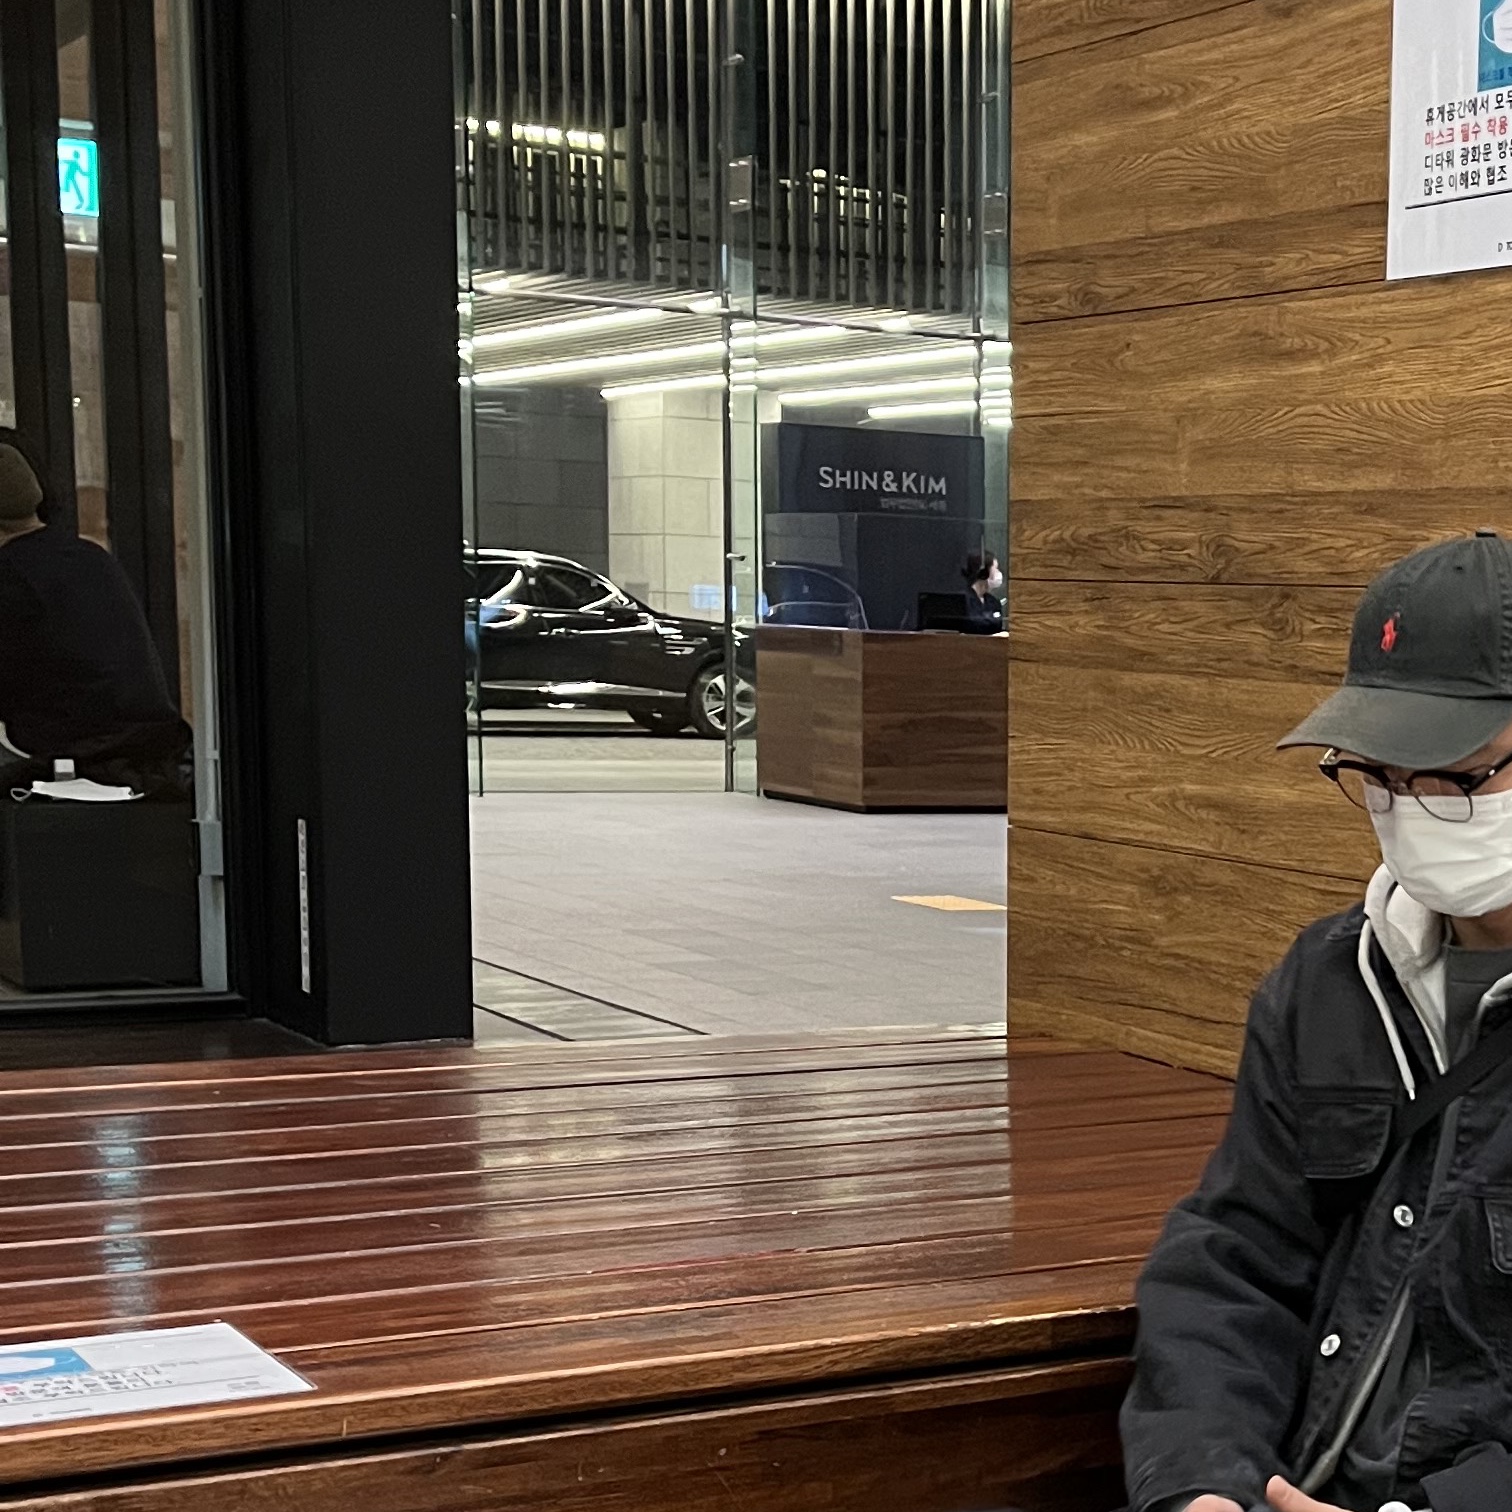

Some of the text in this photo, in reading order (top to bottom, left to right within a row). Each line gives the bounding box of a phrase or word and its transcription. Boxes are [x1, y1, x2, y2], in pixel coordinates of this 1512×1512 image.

[1425, 94, 1490, 126] 휴게공간에서
[1424, 127, 1455, 149] 마스크
[1460, 121, 1481, 142] 필수
[1487, 116, 1508, 137] 착용
[1424, 149, 1455, 172] 디타워
[1460, 143, 1492, 166] 광화문
[1423, 175, 1444, 196] 많은
[1448, 168, 1481, 191] 이해와
[1486, 165, 1507, 186] 협조
